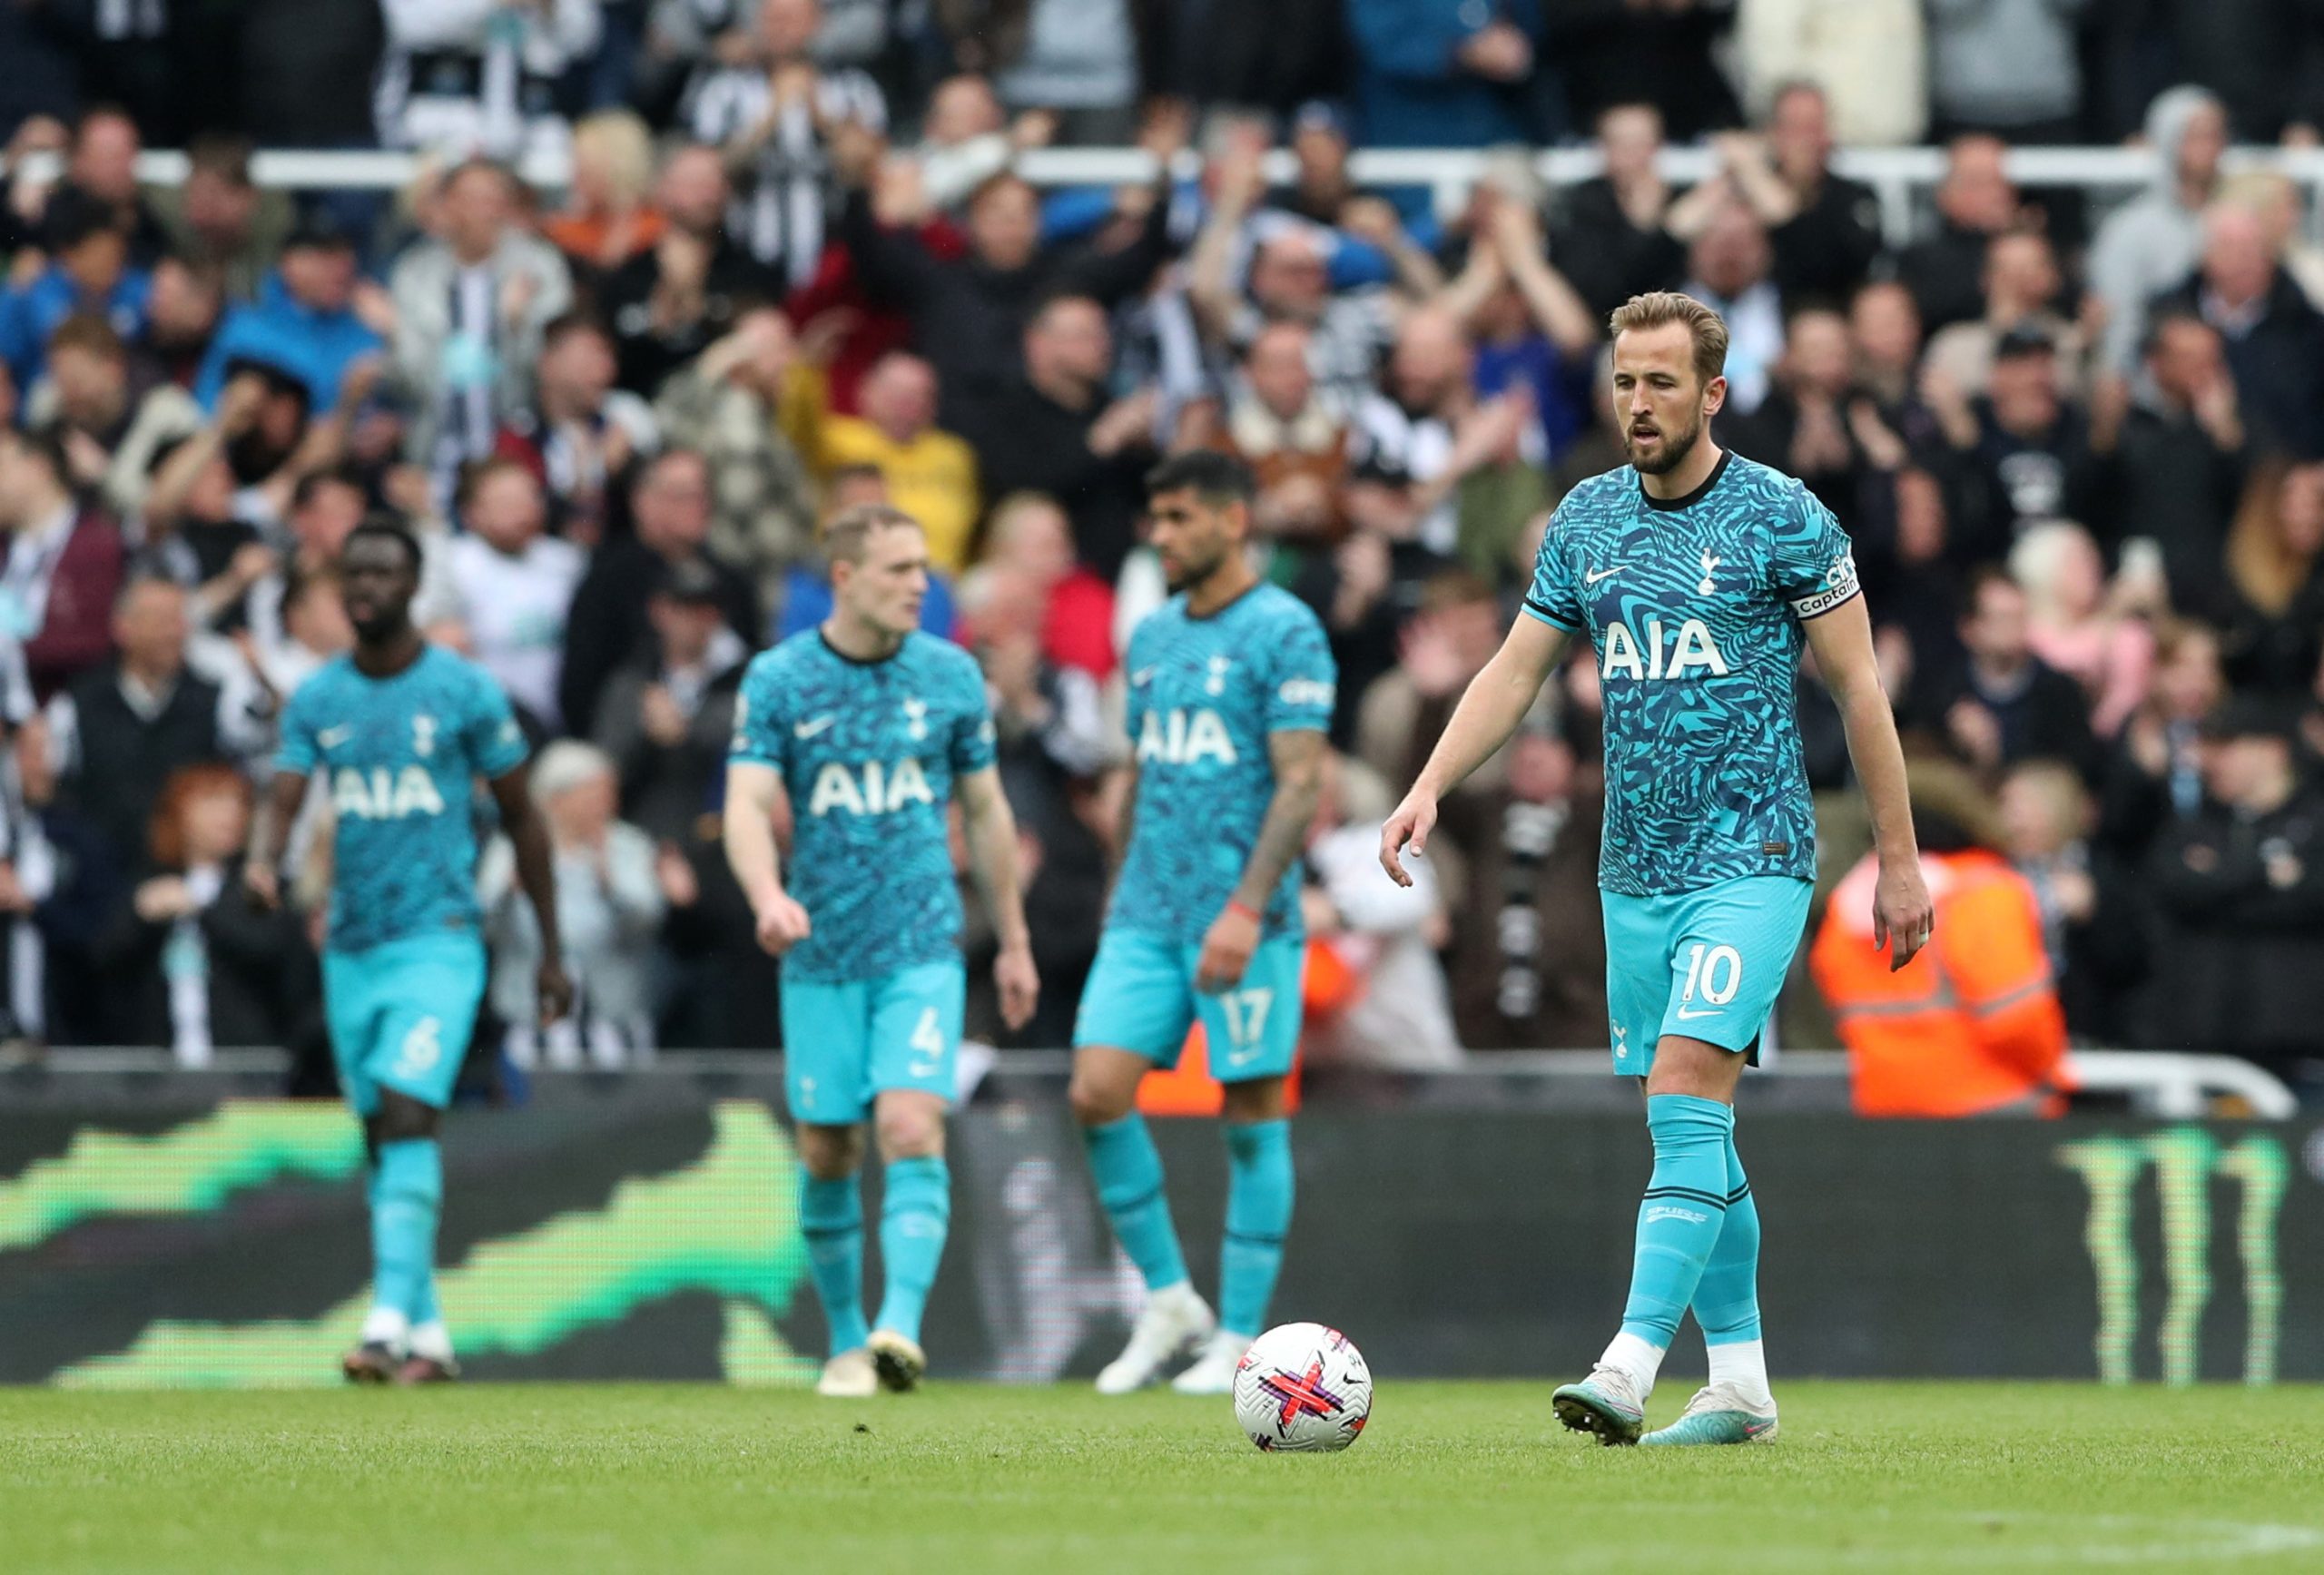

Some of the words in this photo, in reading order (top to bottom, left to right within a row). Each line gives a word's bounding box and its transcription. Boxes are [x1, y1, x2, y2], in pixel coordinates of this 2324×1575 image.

[1799, 579, 1856, 613] Captain
[1602, 618, 1728, 680] AIA
[1137, 708, 1238, 765] AIA
[332, 765, 445, 819] AIA
[809, 757, 934, 816] AIA
[1681, 943, 1742, 1006] 10
[403, 1015, 441, 1070] 6
[910, 1006, 944, 1059] 4
[1220, 988, 1274, 1045] 17
